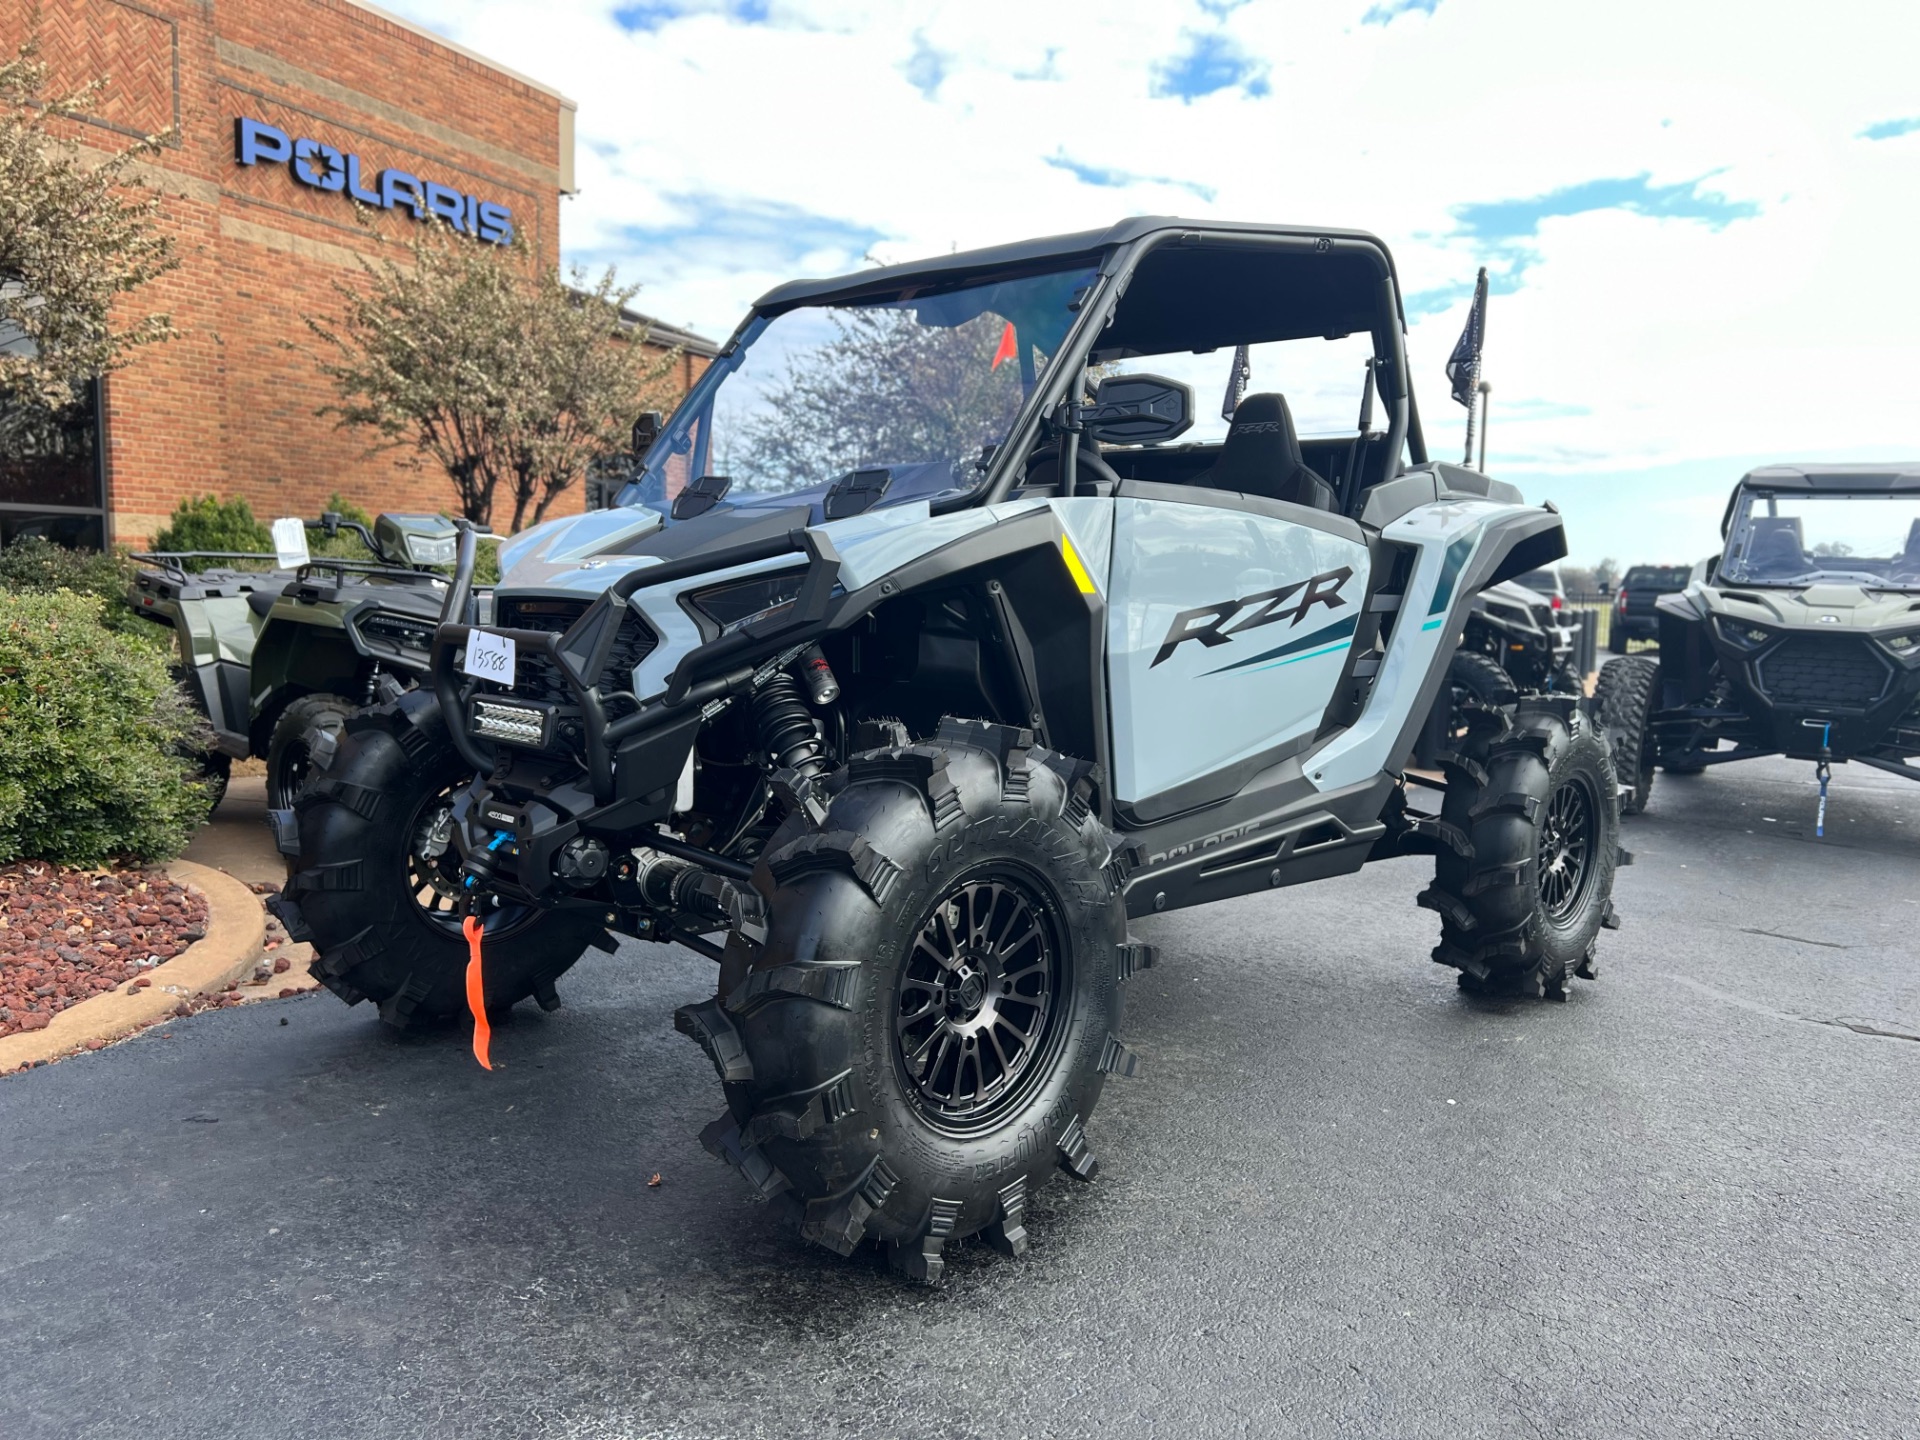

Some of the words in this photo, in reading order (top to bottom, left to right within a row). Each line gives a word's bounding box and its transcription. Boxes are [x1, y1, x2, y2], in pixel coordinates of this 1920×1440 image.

[238, 116, 512, 246] POLARIS
[1232, 421, 1279, 436] RZR
[1149, 565, 1354, 670] RZR
[472, 646, 508, 671] 13588
